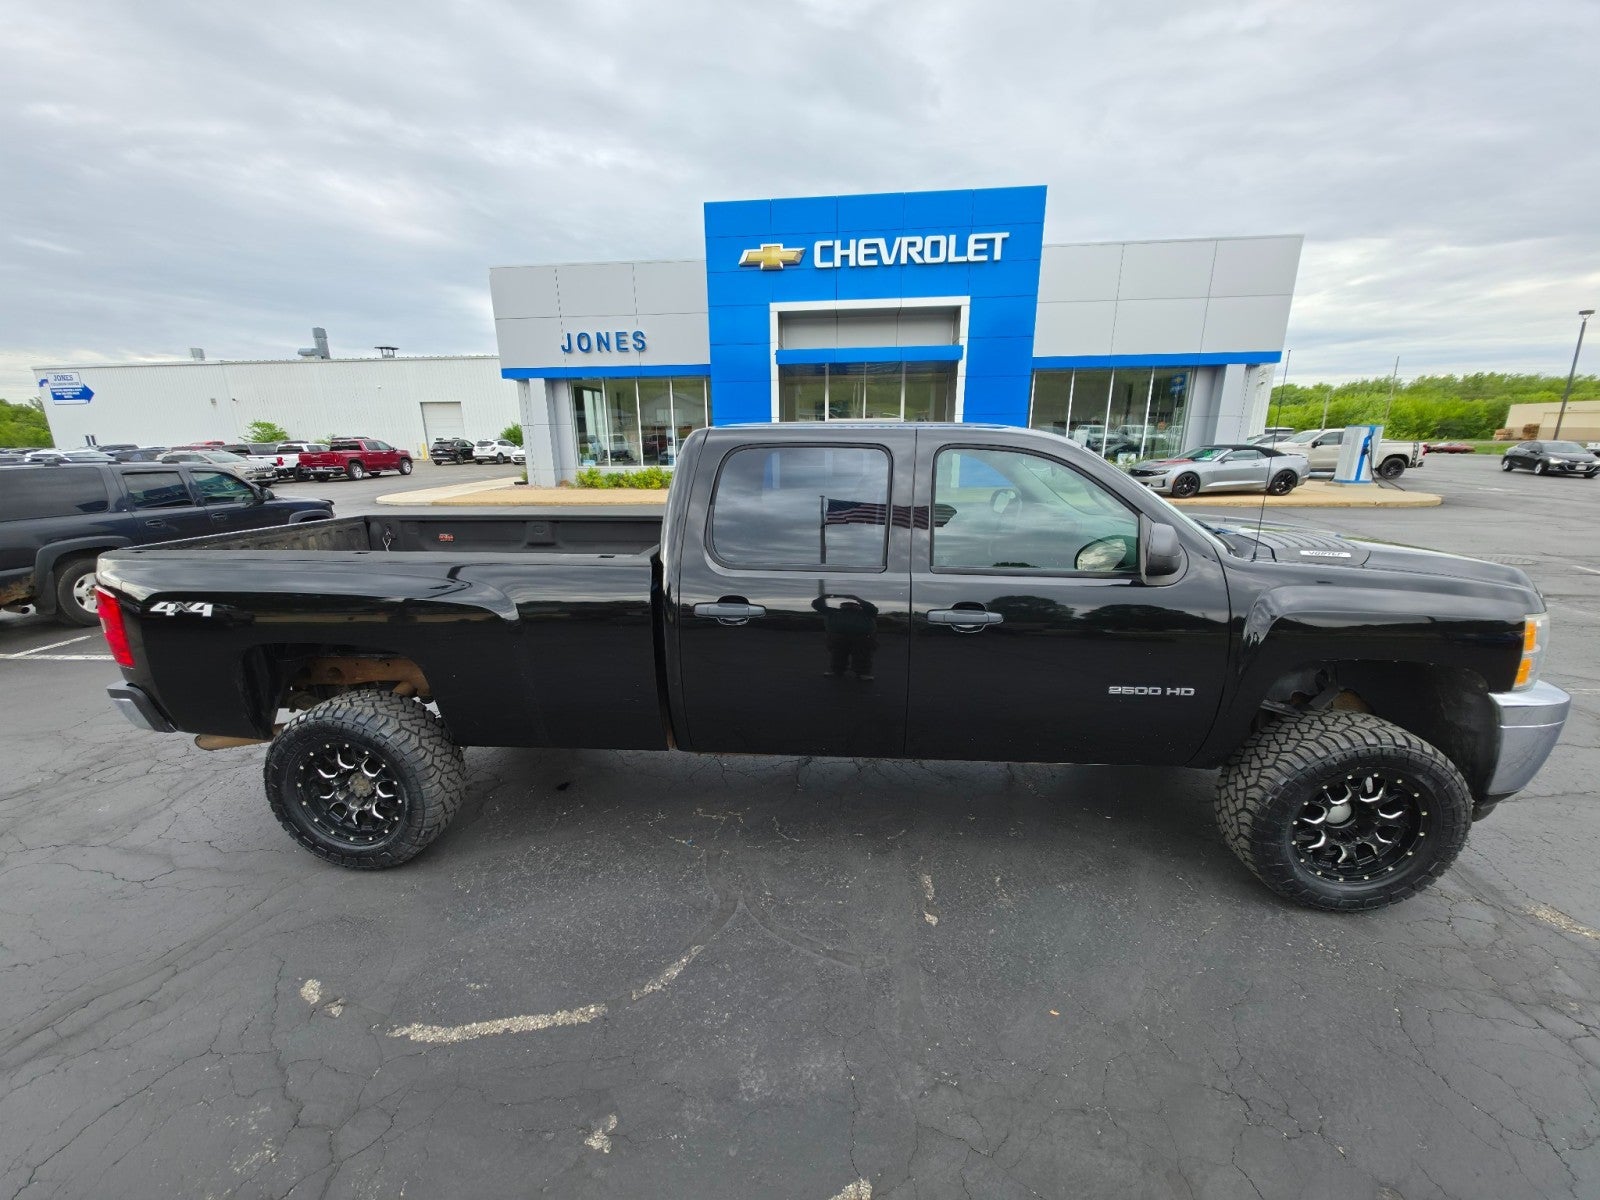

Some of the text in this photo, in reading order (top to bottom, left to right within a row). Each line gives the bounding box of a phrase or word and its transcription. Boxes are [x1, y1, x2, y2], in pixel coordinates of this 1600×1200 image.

[813, 231, 1010, 269] CHEVROLET
[560, 330, 647, 354] JONES
[1108, 686, 1195, 696] 2500 HD
